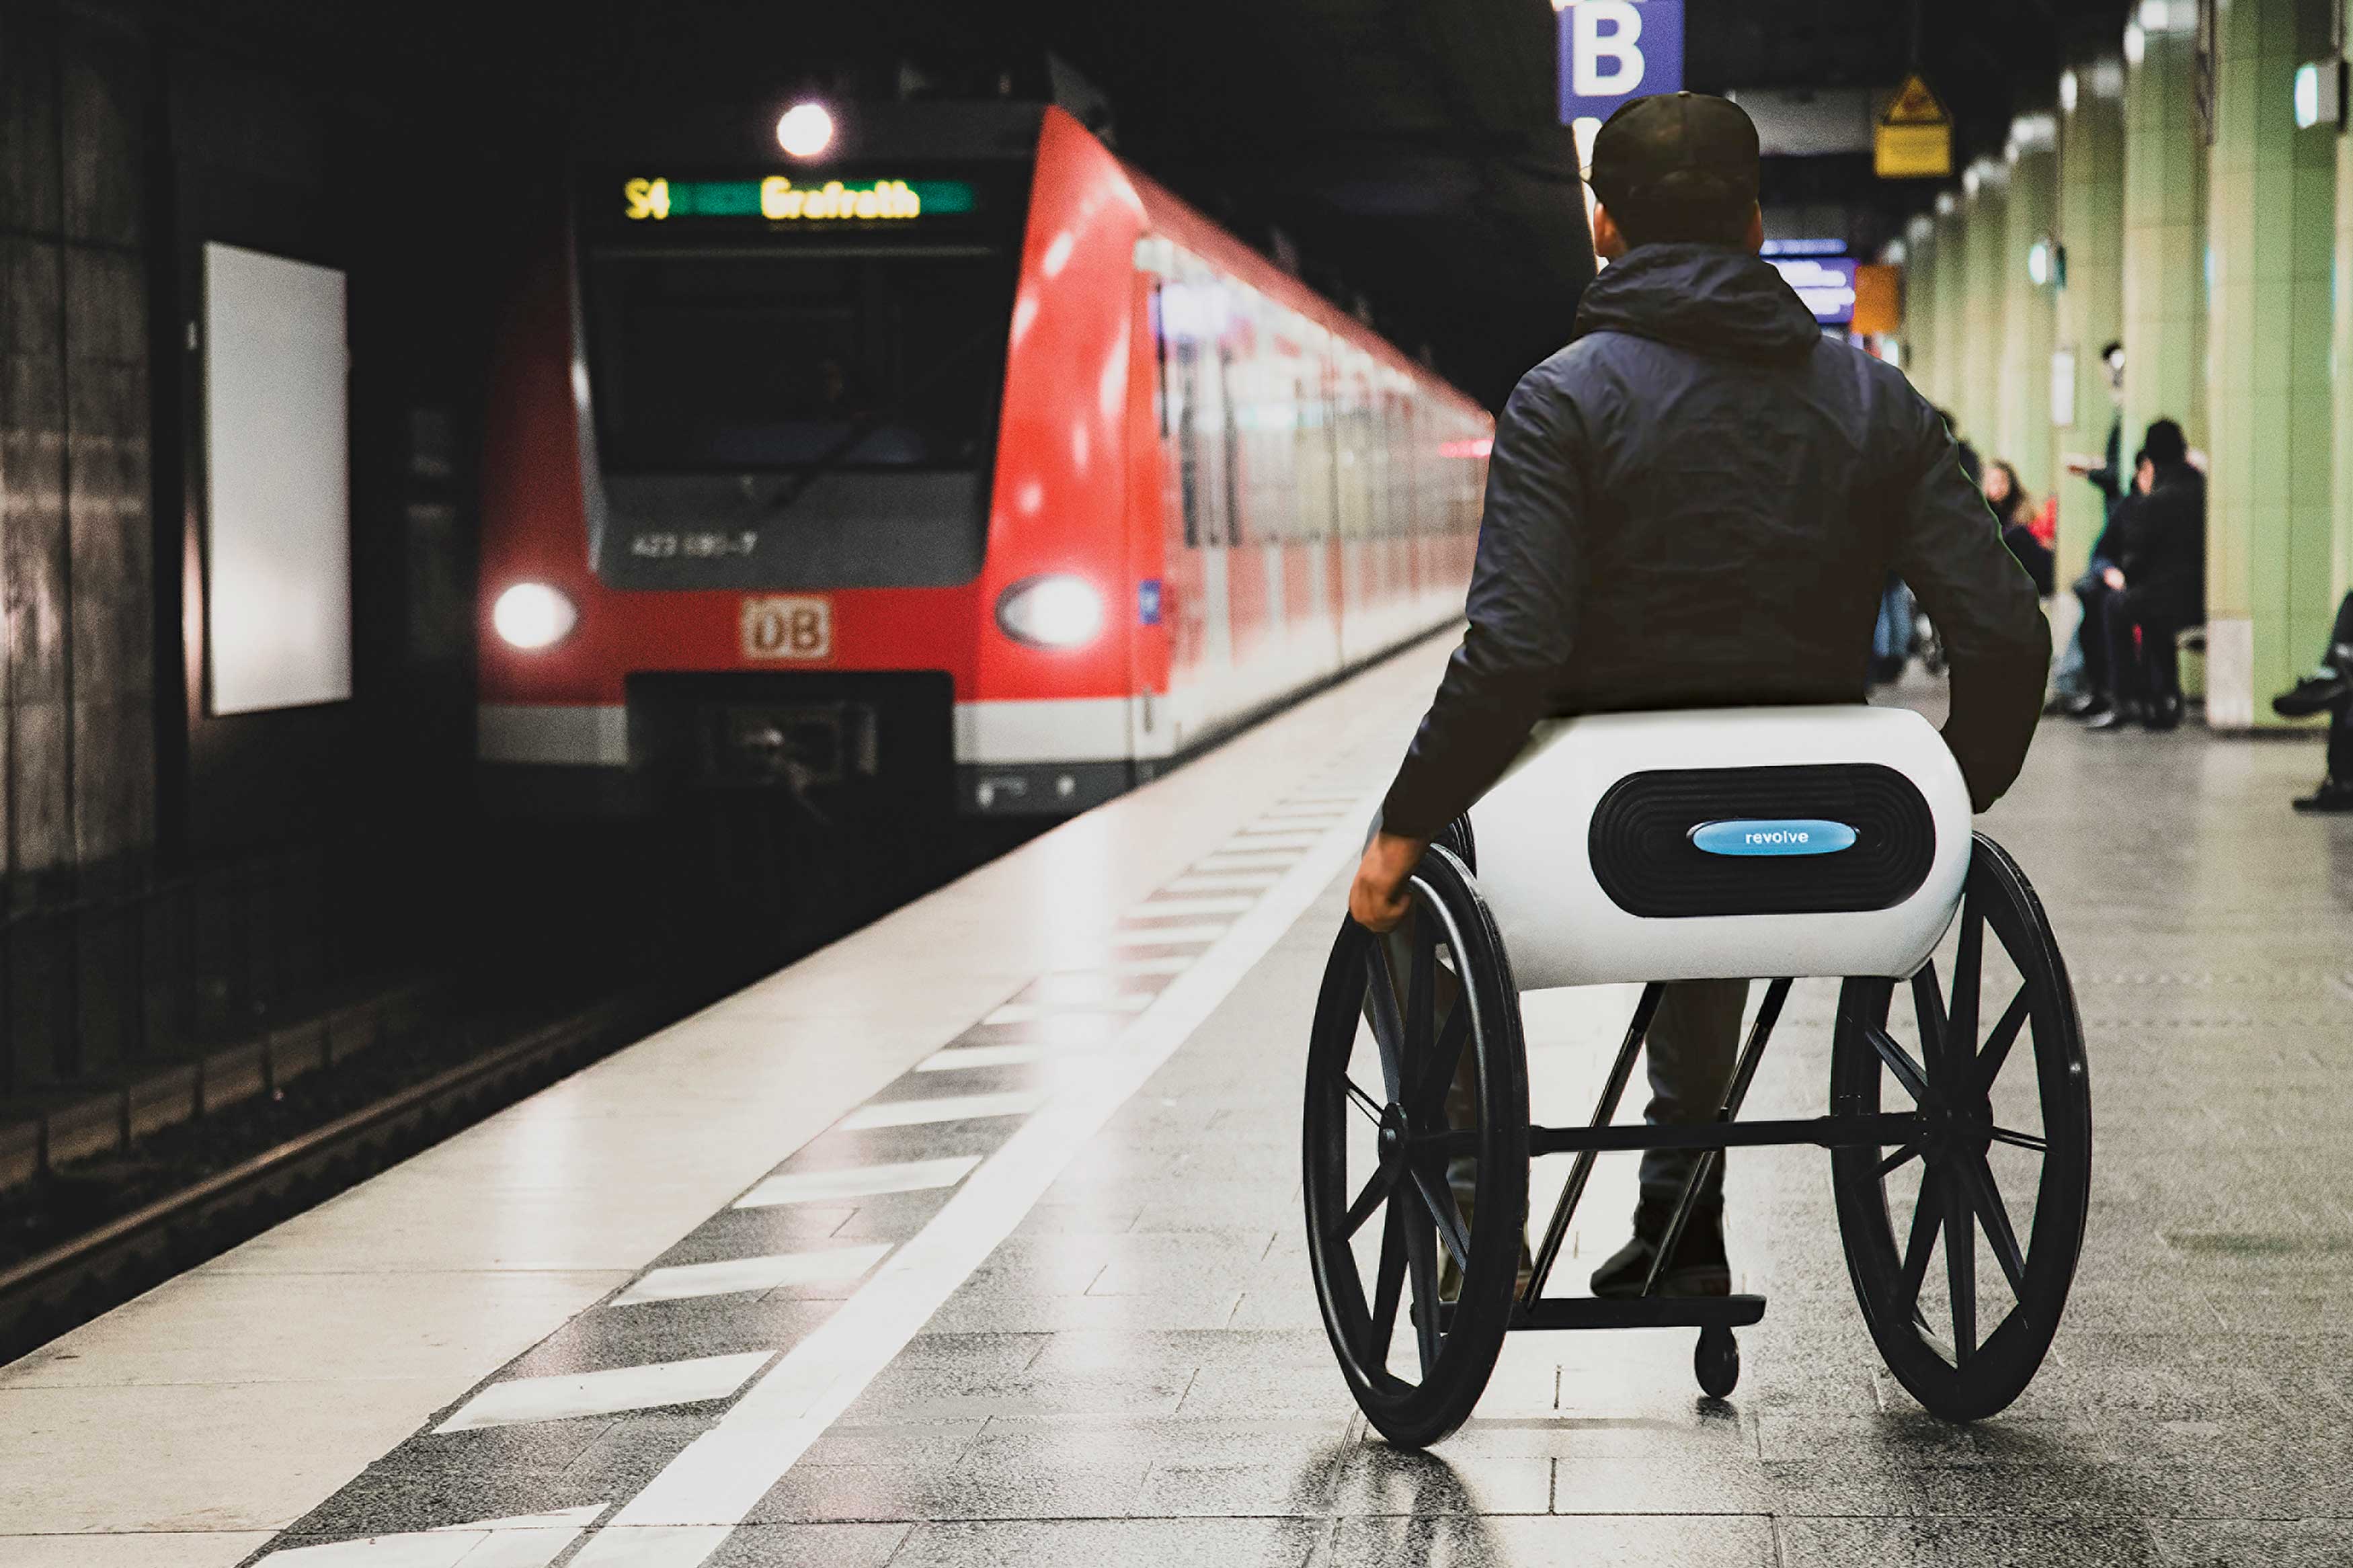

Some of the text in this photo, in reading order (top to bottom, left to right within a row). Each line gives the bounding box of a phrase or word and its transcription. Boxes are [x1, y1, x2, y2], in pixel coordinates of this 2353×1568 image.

[1574, 1, 1645, 95] B
[625, 177, 671, 219] S4
[750, 604, 824, 653] DB
[1746, 831, 1808, 844] revolve
